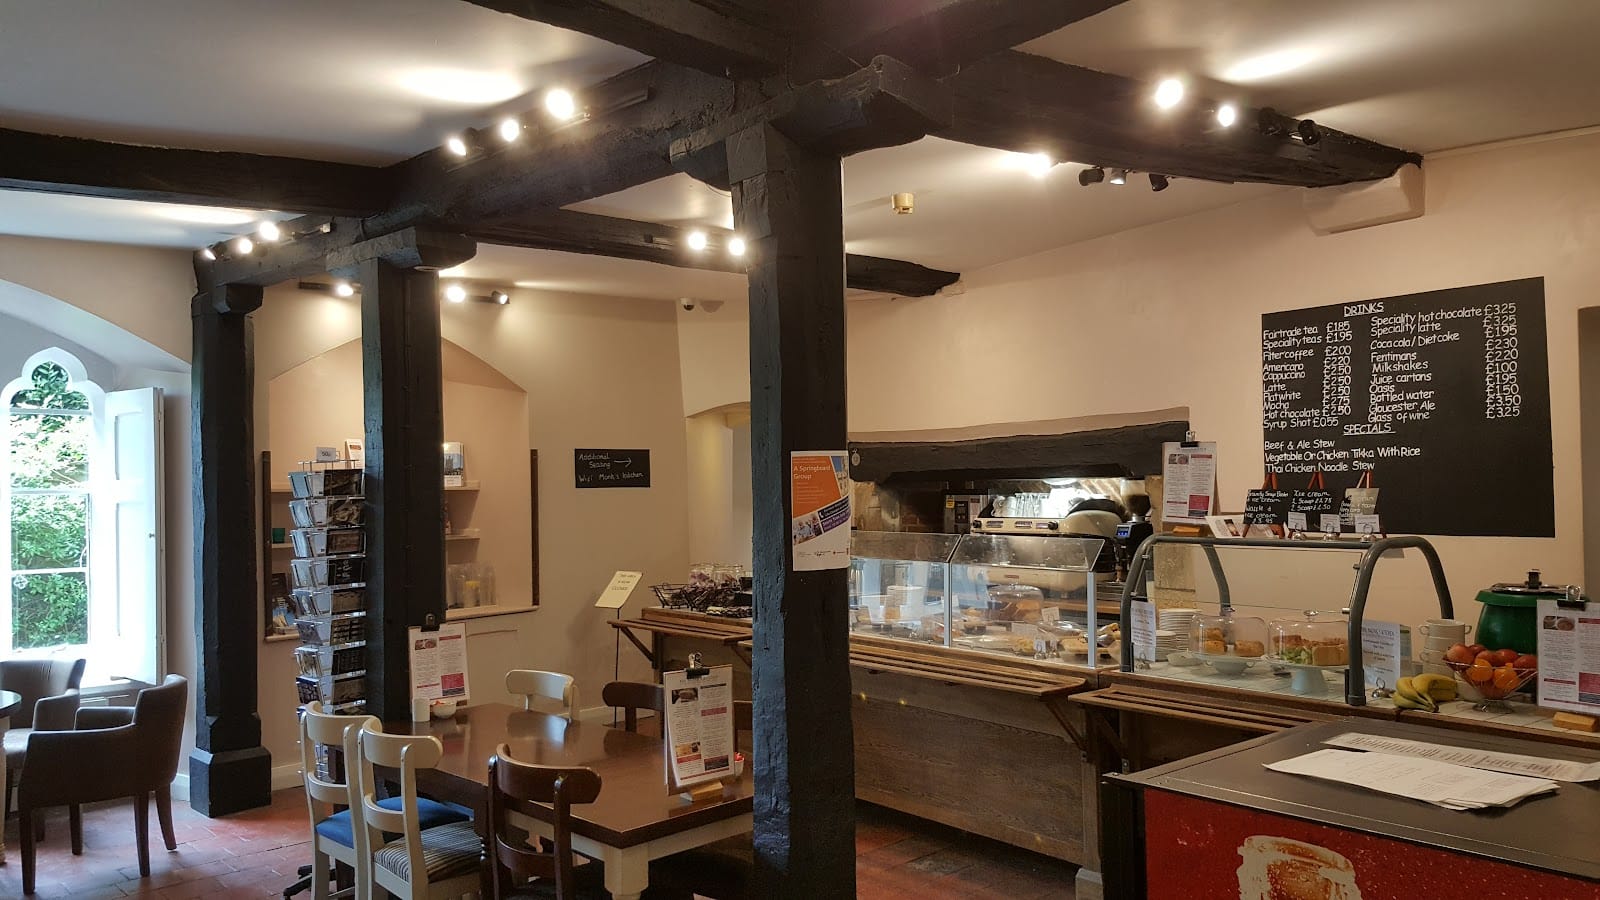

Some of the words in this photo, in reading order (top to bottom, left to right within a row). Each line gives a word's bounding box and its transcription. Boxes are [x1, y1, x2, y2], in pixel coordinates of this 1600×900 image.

[1343, 302, 1385, 317] DRINKS
[1371, 313, 1416, 328] Speciality
[1435, 307, 1482, 319] chocolate
[1263, 327, 1302, 340] Fairtrade
[1303, 326, 1319, 335] tea
[1371, 323, 1416, 338] Speciality
[1418, 322, 1441, 333] latte
[1263, 337, 1302, 351] Speciality
[1302, 336, 1323, 345] teas
[1263, 351, 1283, 361] Filter
[1284, 349, 1314, 361] coffee
[1371, 351, 1417, 362] Fentimans
[1263, 362, 1304, 372] Americano
[1372, 360, 1429, 373] Milkshakes
[1263, 371, 1306, 383] Cappuccino
[1370, 374, 1393, 385] Juice
[1396, 373, 1432, 383] cartons
[1264, 383, 1287, 393] Latte
[1369, 384, 1395, 394] Oasis
[1370, 391, 1404, 404] Bottled
[1406, 390, 1435, 401] water
[1263, 401, 1290, 410] Mocha
[1369, 402, 1418, 414] Gloucester
[1420, 401, 1436, 411] Ale
[1486, 395, 1522, 408] £3.50
[1263, 410, 1279, 420] Hot
[1280, 408, 1320, 418] chocolate
[1368, 413, 1393, 424] Glass
[1396, 413, 1408, 424] of
[1409, 411, 1430, 421] wine
[1263, 420, 1288, 432] Syrup
[1290, 418, 1311, 428] Shot
[1343, 423, 1394, 435] SPECIALS
[1265, 441, 1285, 451] Beef
[1287, 441, 1294, 450] &
[1297, 440, 1311, 450] Ale
[1313, 439, 1336, 449] Stew
[1265, 452, 1303, 465] Vegetable
[1304, 452, 1316, 461] Or
[1317, 450, 1350, 461] Chicken
[1351, 449, 1375, 459] Tikka
[1377, 447, 1401, 458] With
[1401, 447, 1421, 457] Rice
[1266, 463, 1284, 474] Thai
[1285, 463, 1316, 473] Chicken
[1317, 462, 1349, 472] Noodle
[1352, 461, 1375, 471] Stew
